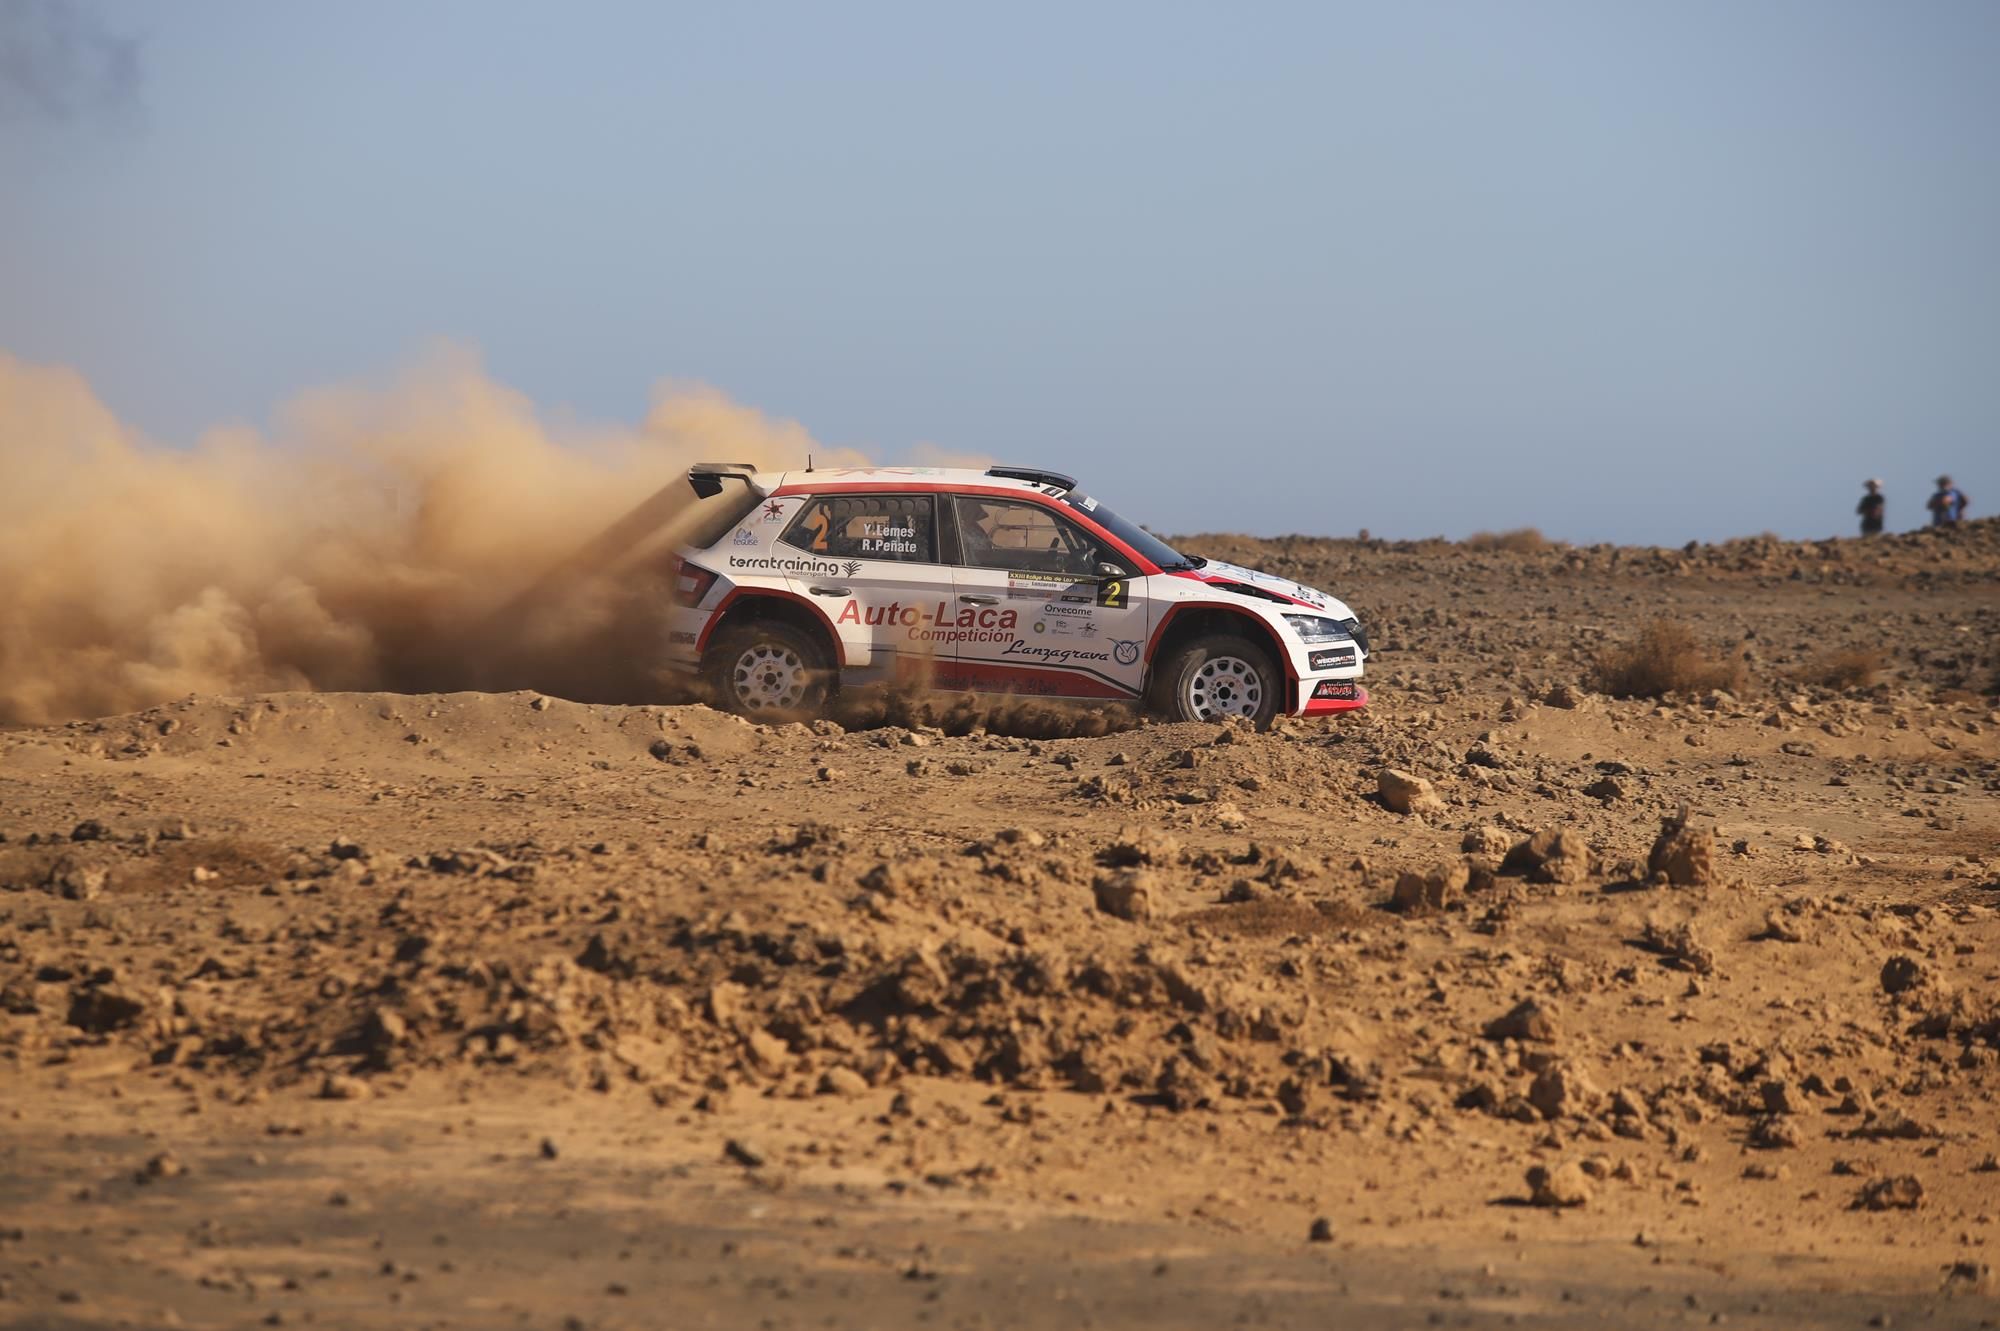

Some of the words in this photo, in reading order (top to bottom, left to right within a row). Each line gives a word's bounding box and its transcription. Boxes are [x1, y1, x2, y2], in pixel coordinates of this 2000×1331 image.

[812, 513, 829, 550] 2
[863, 523, 914, 538] Y.Lemes
[862, 539, 917, 553] R.Peñate
[729, 555, 839, 576] terratraining
[1104, 581, 1121, 606] 2
[837, 599, 1018, 629] Auto-Laca
[908, 627, 1015, 644] Competición
[1001, 640, 1111, 663] Lanzagrava
